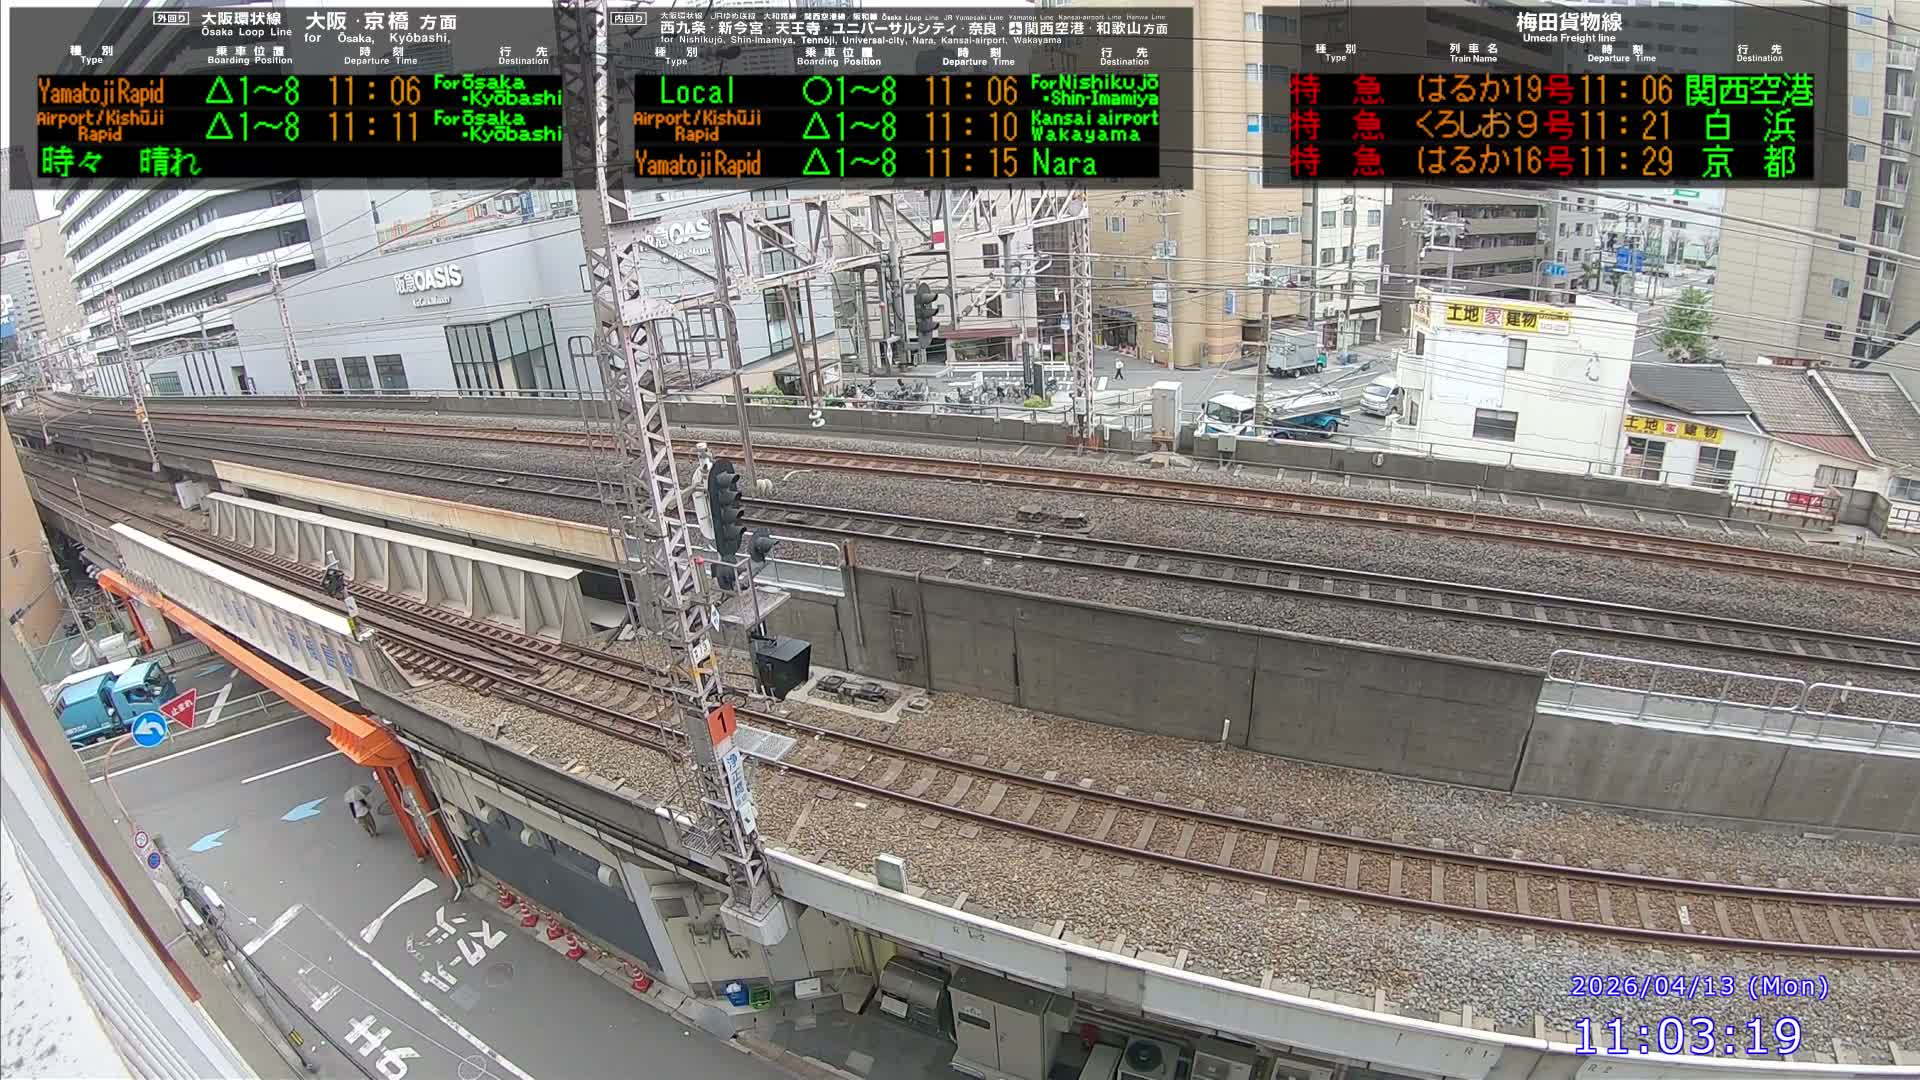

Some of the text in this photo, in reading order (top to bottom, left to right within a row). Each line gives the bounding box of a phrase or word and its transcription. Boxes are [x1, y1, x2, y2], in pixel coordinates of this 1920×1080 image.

[171, 699, 194, 717] 止まれ
[717, 711, 728, 733] 1
